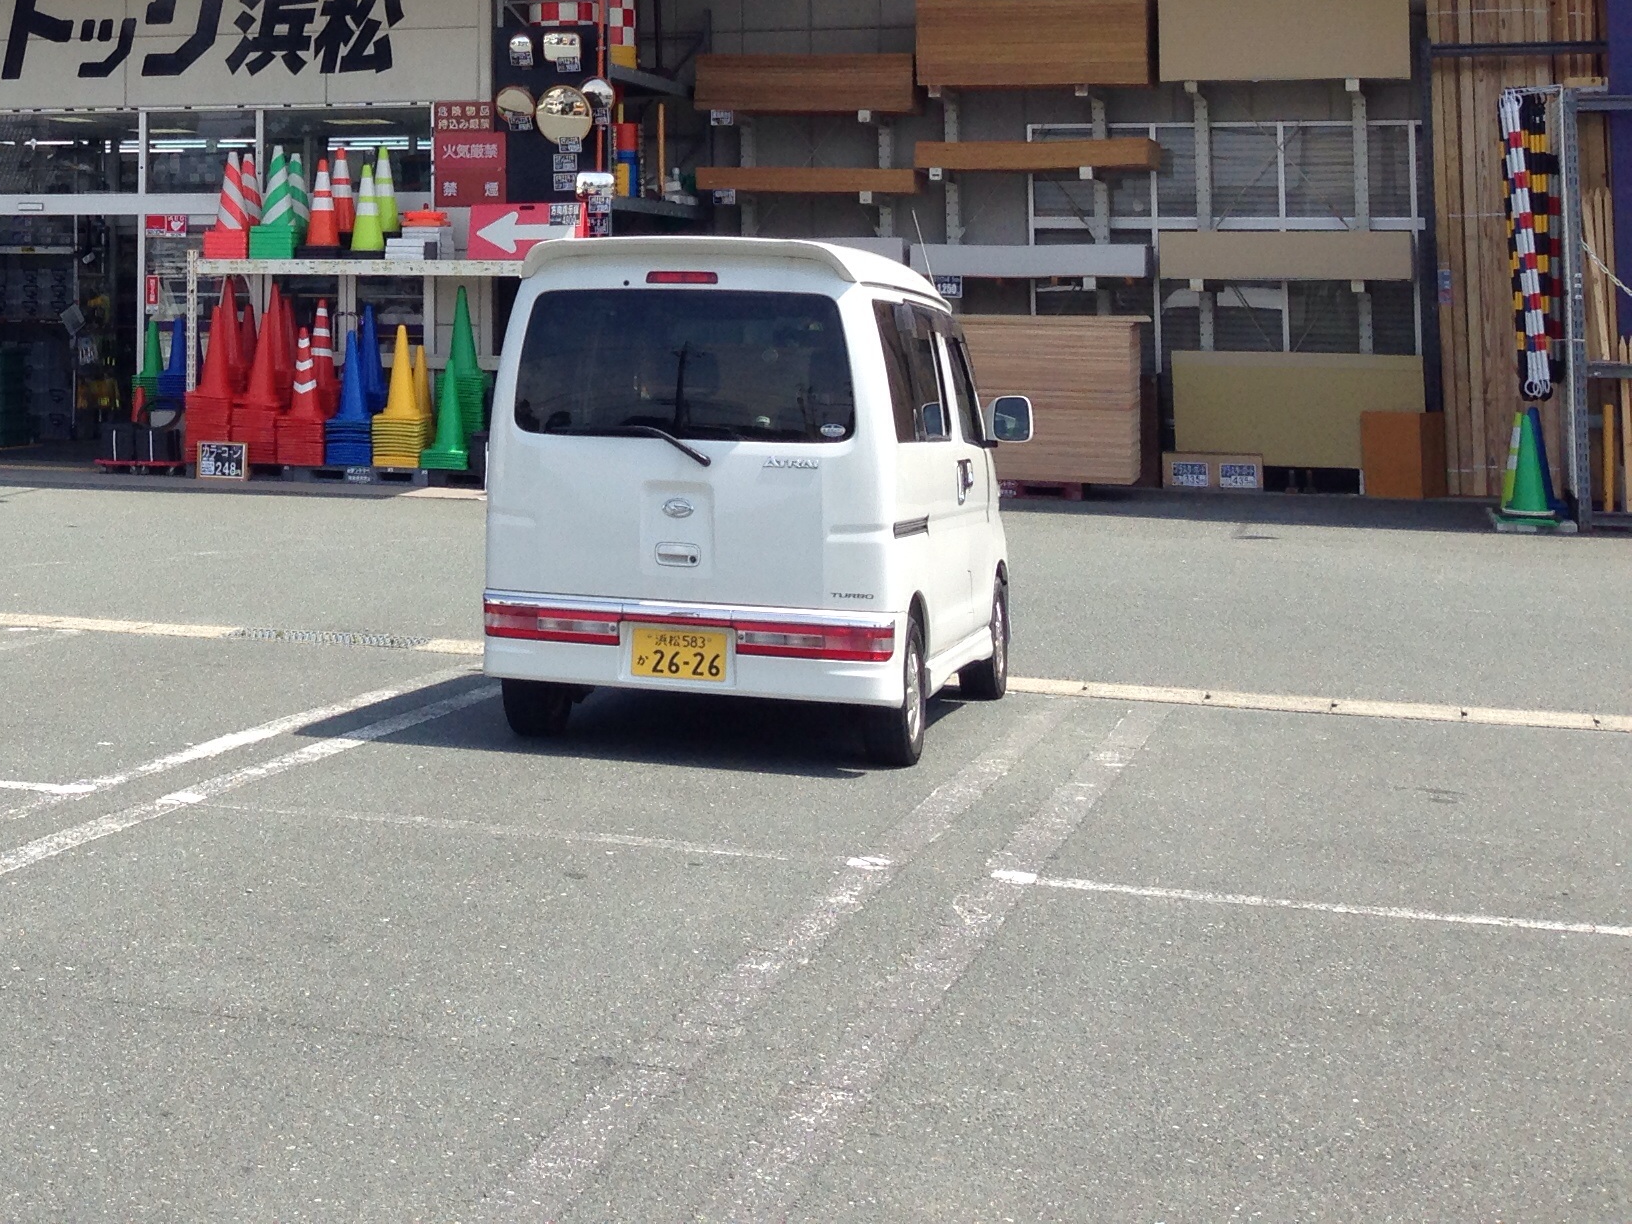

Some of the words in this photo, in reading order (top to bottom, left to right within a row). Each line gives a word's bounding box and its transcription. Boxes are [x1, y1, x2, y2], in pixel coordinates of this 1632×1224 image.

[442, 143, 498, 159] 火気厳禁
[202, 443, 242, 459] カラーコーン
[829, 591, 875, 600] TURBO
[655, 633, 706, 649] 浜松583
[637, 654, 649, 666] か
[651, 649, 720, 677] 26-26
